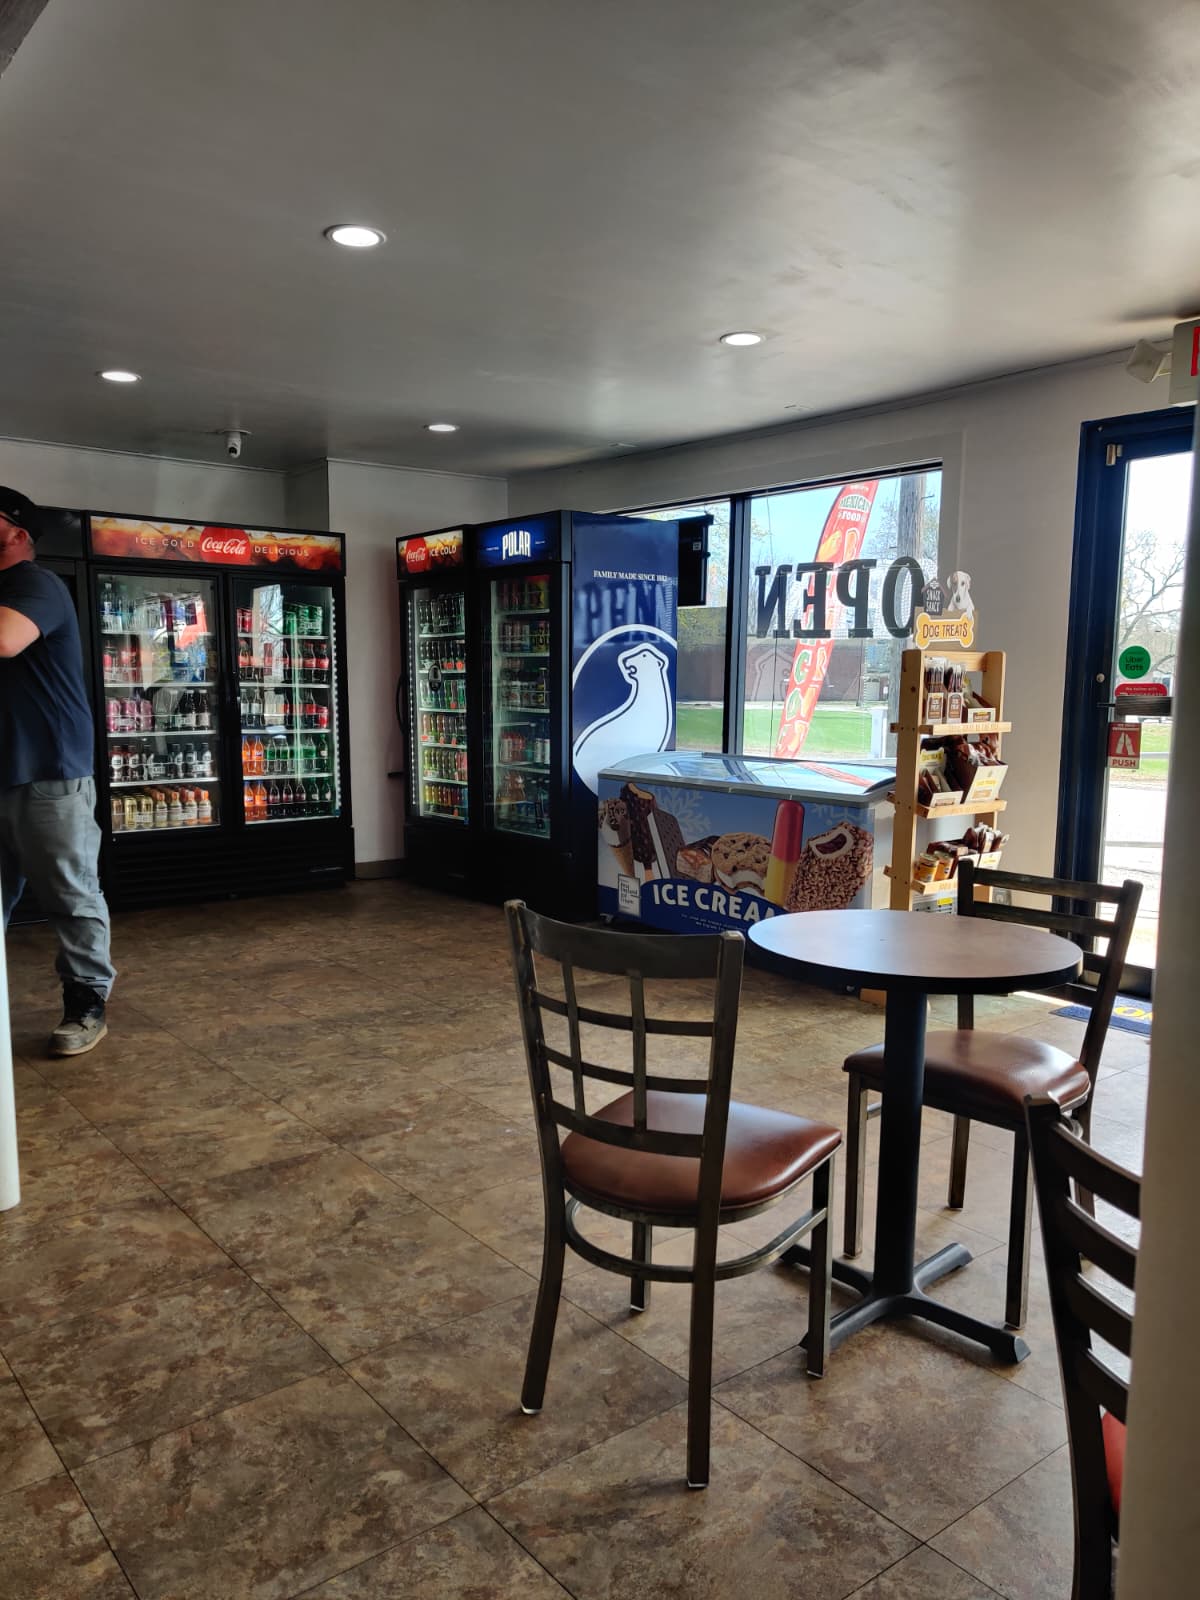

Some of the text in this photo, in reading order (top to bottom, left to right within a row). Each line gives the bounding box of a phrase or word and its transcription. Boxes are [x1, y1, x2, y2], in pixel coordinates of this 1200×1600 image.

[135, 536, 195, 549] ICE COLD
[502, 530, 532, 561] POLAR
[254, 545, 310, 558] DELICIOUS
[429, 546, 457, 558] ICE COLD
[593, 569, 618, 579] FAMILY
[618, 571, 638, 580] MADE
[638, 573, 656, 582] SINCE
[922, 622, 968, 639] DOG TREATS
[1112, 759, 1136, 767] PUSH
[653, 884, 690, 907] ICE
